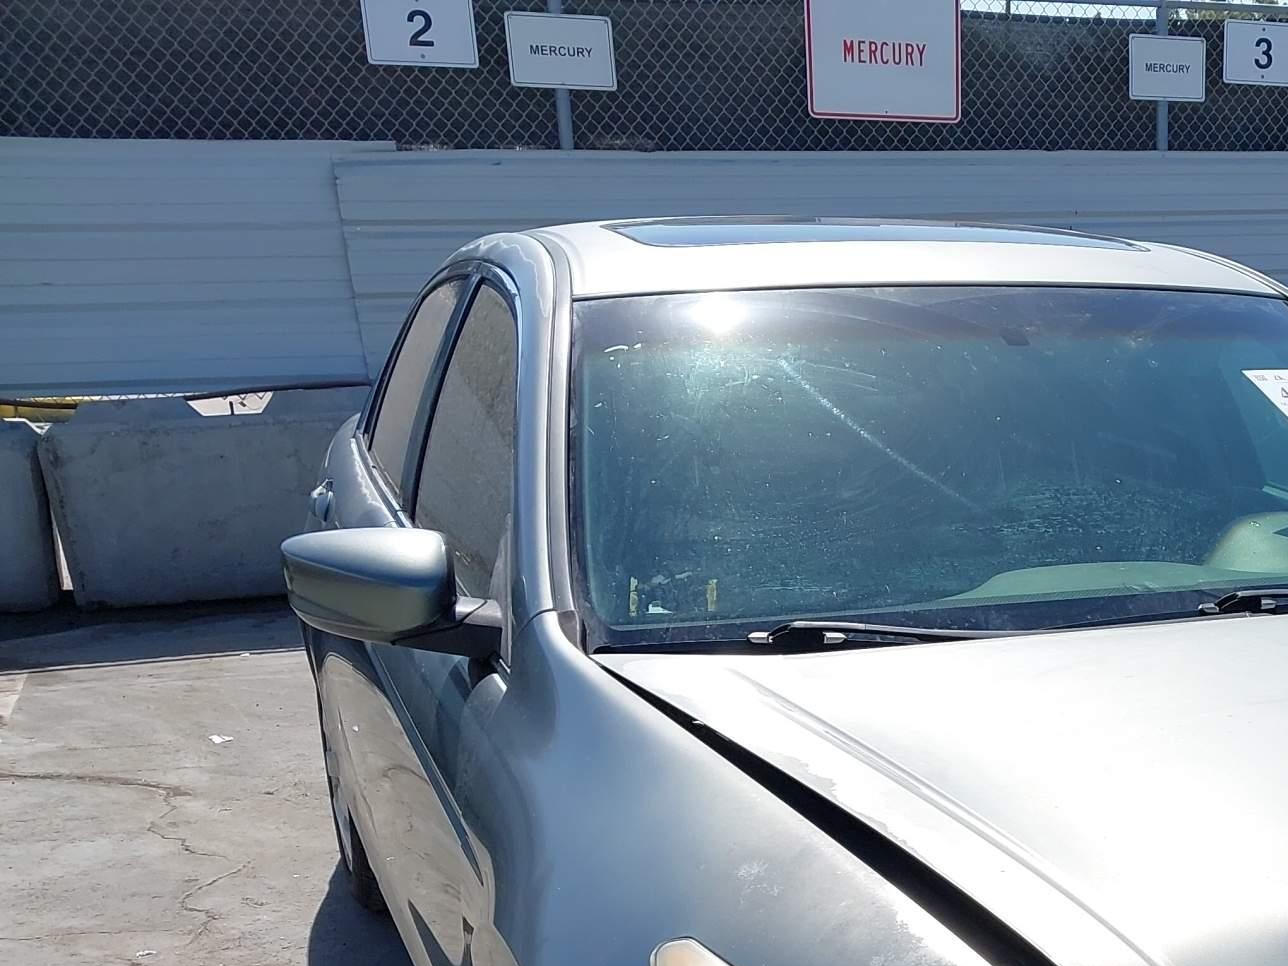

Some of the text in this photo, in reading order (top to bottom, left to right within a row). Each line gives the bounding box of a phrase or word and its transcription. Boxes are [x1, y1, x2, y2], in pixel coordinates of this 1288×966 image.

[406, 9, 435, 47] 2
[529, 44, 593, 58] MERCURY
[842, 39, 927, 67] MERCURY
[1254, 37, 1273, 70] 3
[1145, 62, 1191, 74] MERCURY
